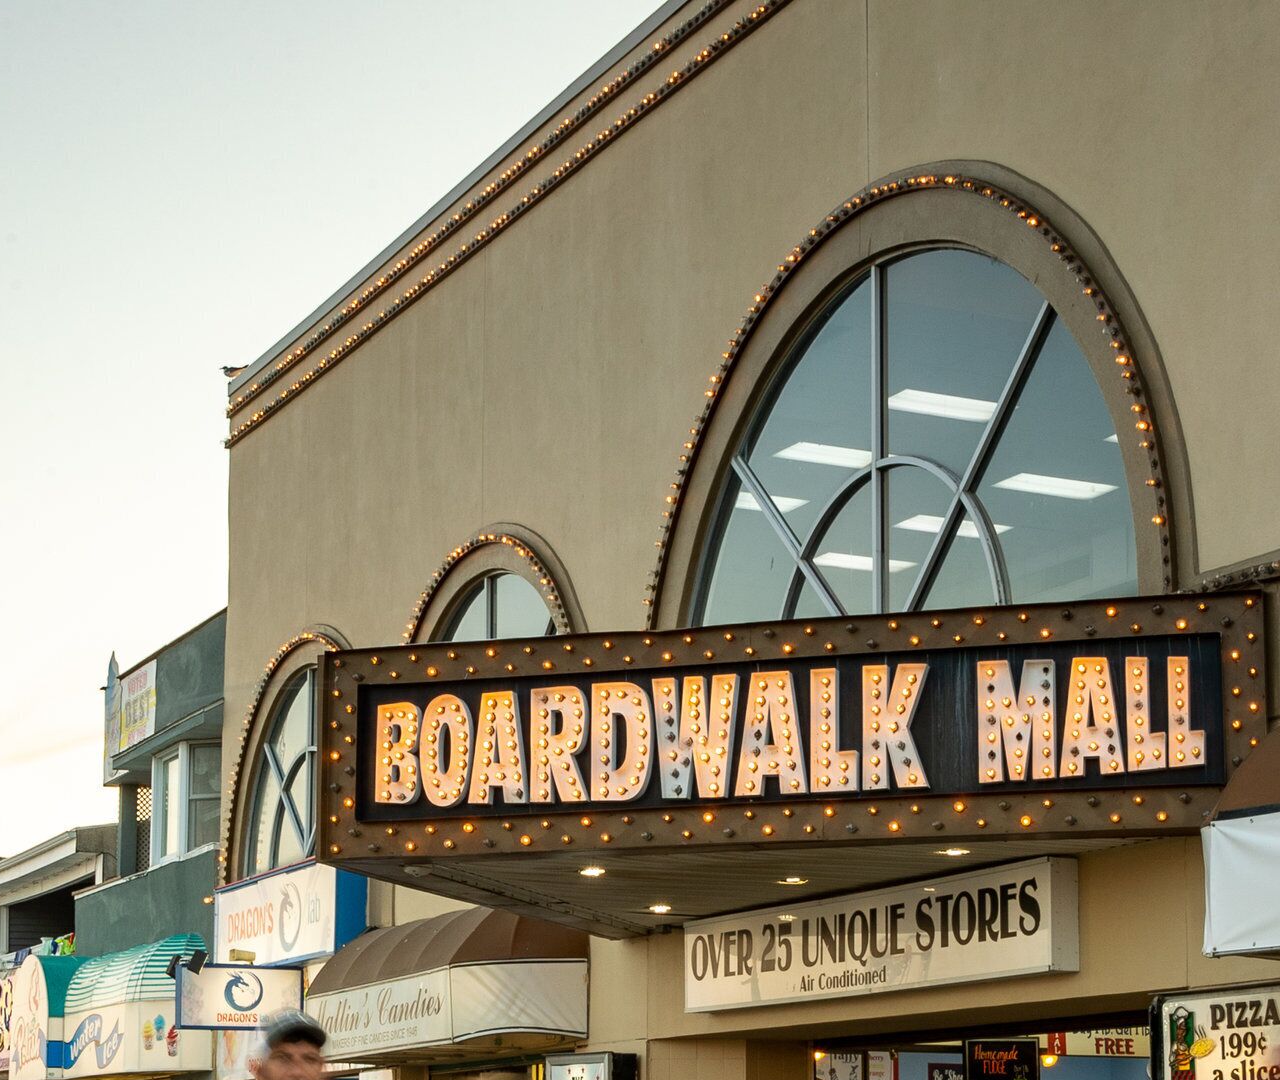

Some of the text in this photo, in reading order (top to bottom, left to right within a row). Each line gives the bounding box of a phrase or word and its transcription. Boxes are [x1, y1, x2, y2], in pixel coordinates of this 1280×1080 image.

[375, 656, 1206, 805] BOARDWALK MALL
[228, 902, 274, 943] DRAGON'S
[691, 877, 1041, 981] OVER 25 UNIQUE STORES
[799, 966, 887, 992] Air Conditioned
[217, 1013, 258, 1023] DRAGON'S
[377, 987, 445, 1025] Candies
[70, 1018, 101, 1061] Water
[103, 1033, 119, 1064] Ice
[331, 1036, 351, 1050] MAKERS
[351, 1035, 358, 1045] OF
[358, 1033, 369, 1045] FINE
[368, 1030, 390, 1044] CANDIES
[390, 1028, 405, 1041] SINCE
[1095, 1038, 1135, 1055] FREE
[983, 1060, 1008, 1075] FUDGE
